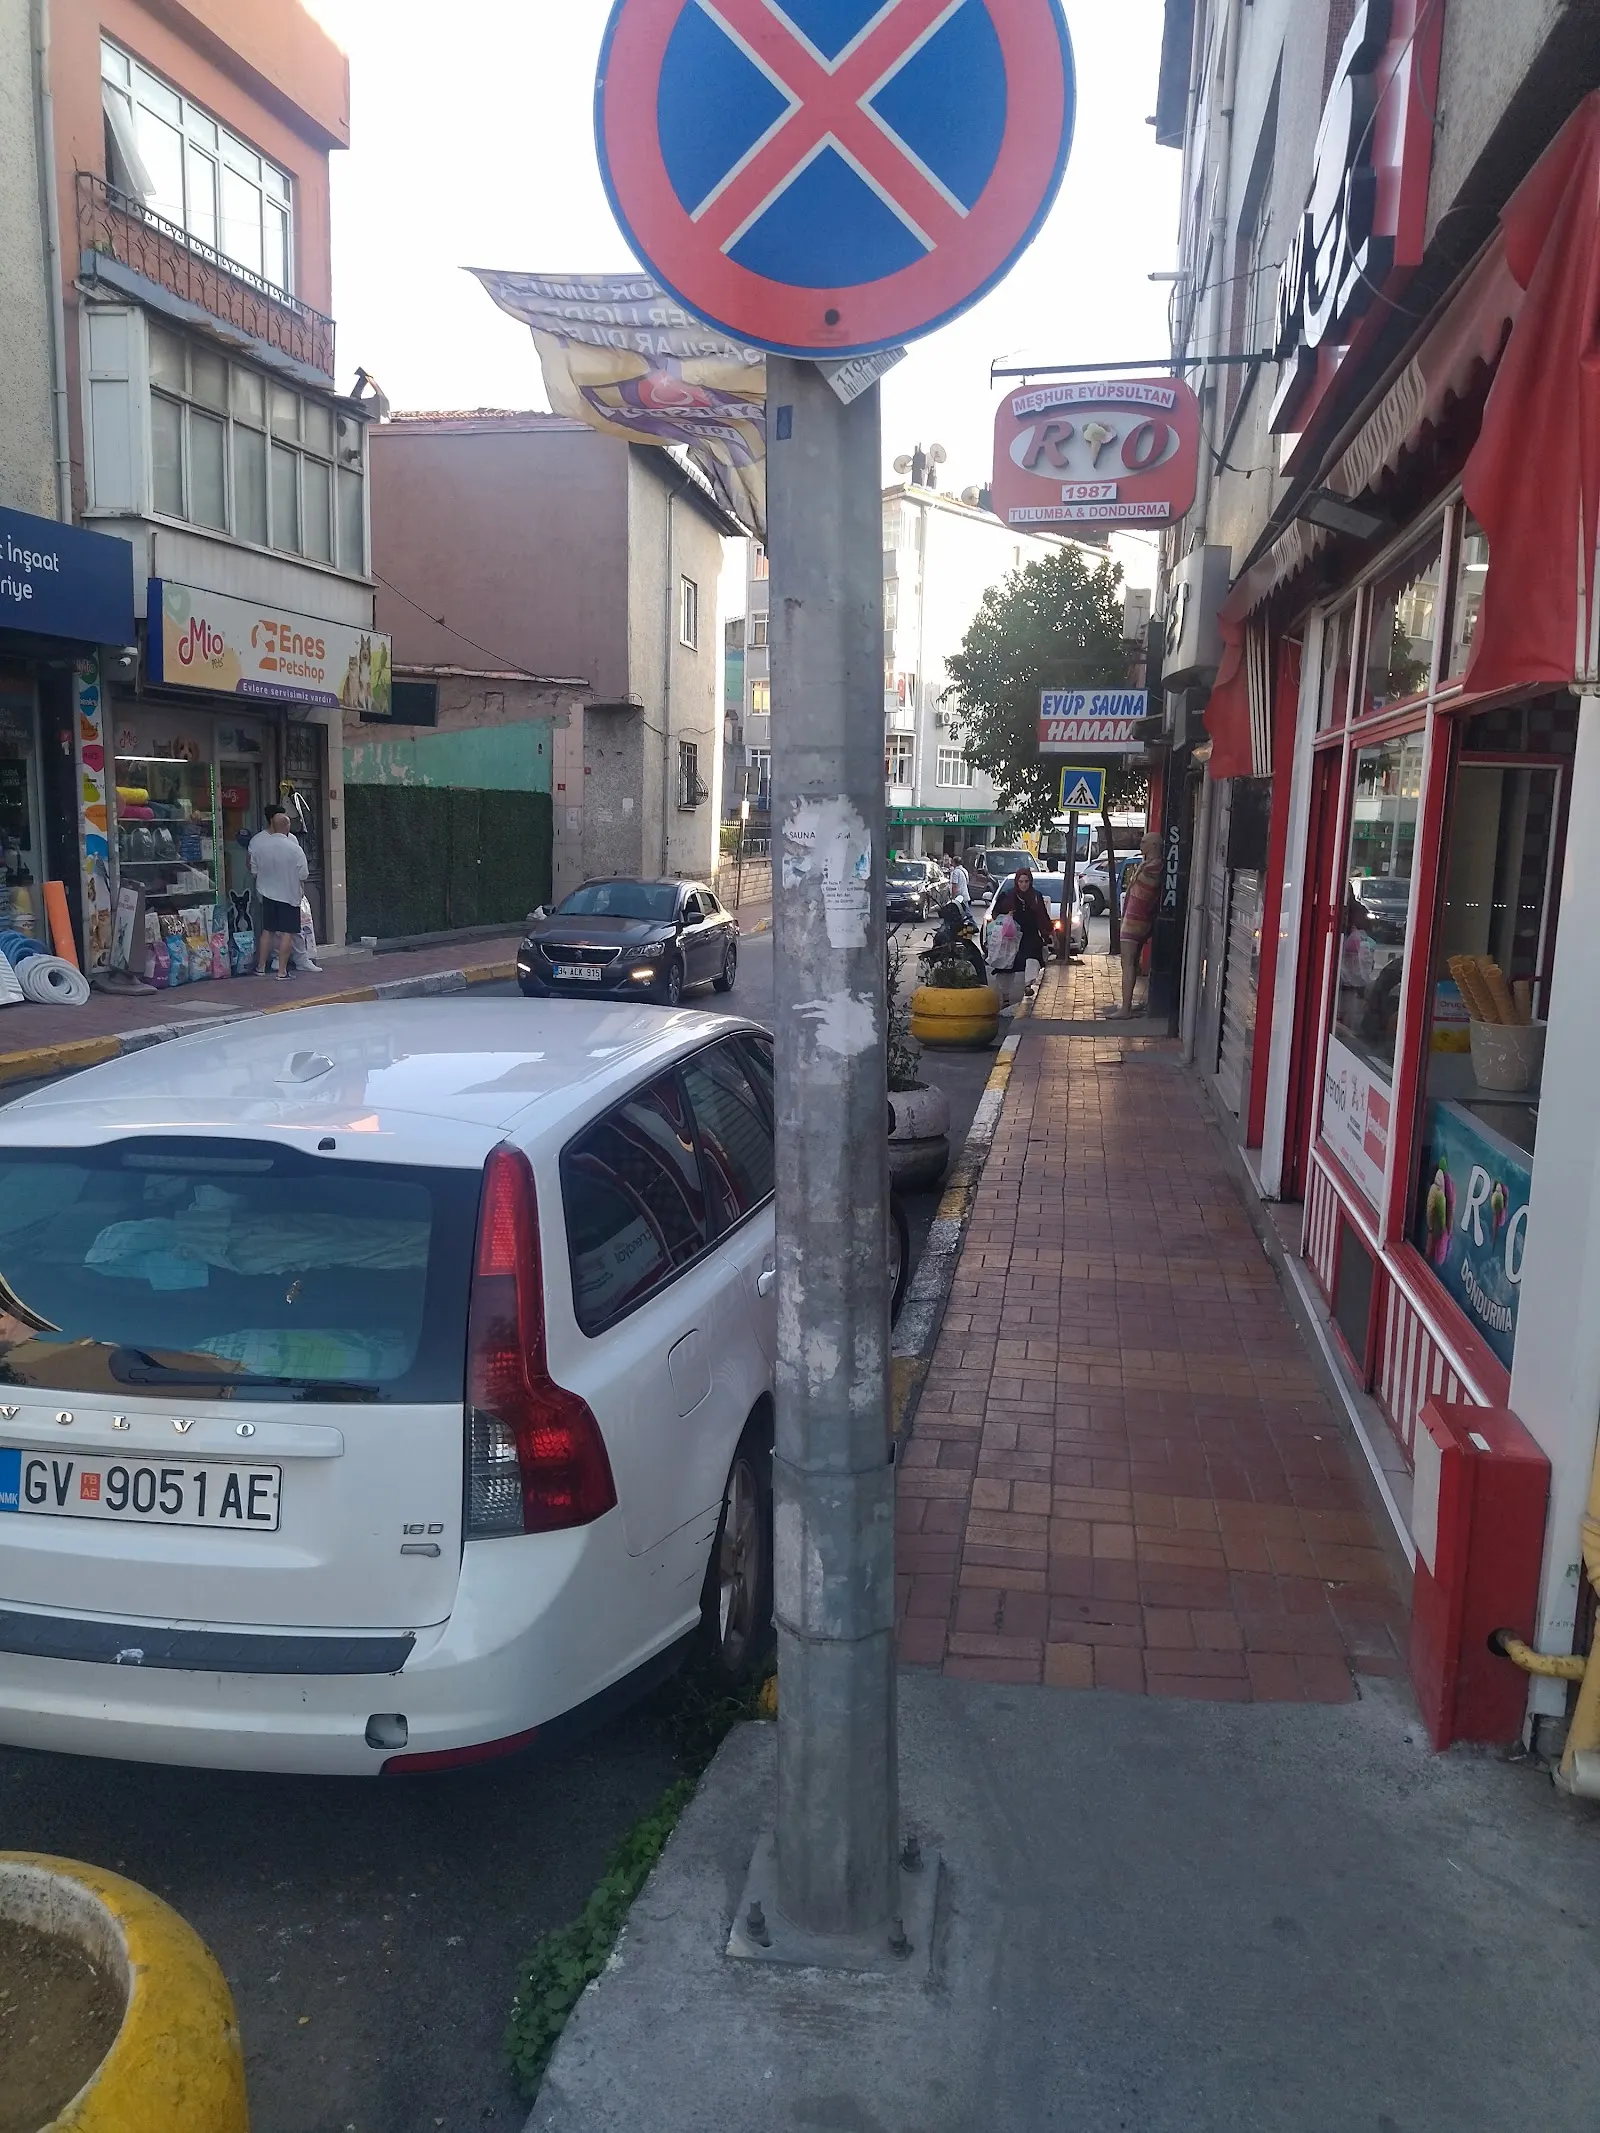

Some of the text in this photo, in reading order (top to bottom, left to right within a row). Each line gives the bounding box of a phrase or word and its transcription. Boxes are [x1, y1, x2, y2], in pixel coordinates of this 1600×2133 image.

[1014, 382, 1172, 413] MEŞHUR EYÜPSULTAN
[1065, 486, 1113, 499] 1987
[1010, 504, 1167, 521] TULUMBA & DONDURMA
[7, 534, 60, 573] İnşaat
[279, 624, 326, 661] Enes
[279, 657, 325, 684] Petshop
[243, 682, 269, 696] Evlere
[271, 688, 309, 702] servisimiz
[1042, 690, 1144, 716] EYÜP SAUNA
[789, 831, 816, 839] SAUNA
[1165, 825, 1180, 906] SAUNA
[1460, 1256, 1513, 1333] DONDURMA
[0, 1406, 256, 1438] VOLVO
[25, 1459, 74, 1507] GV
[106, 1465, 273, 1520] 9051 AE
